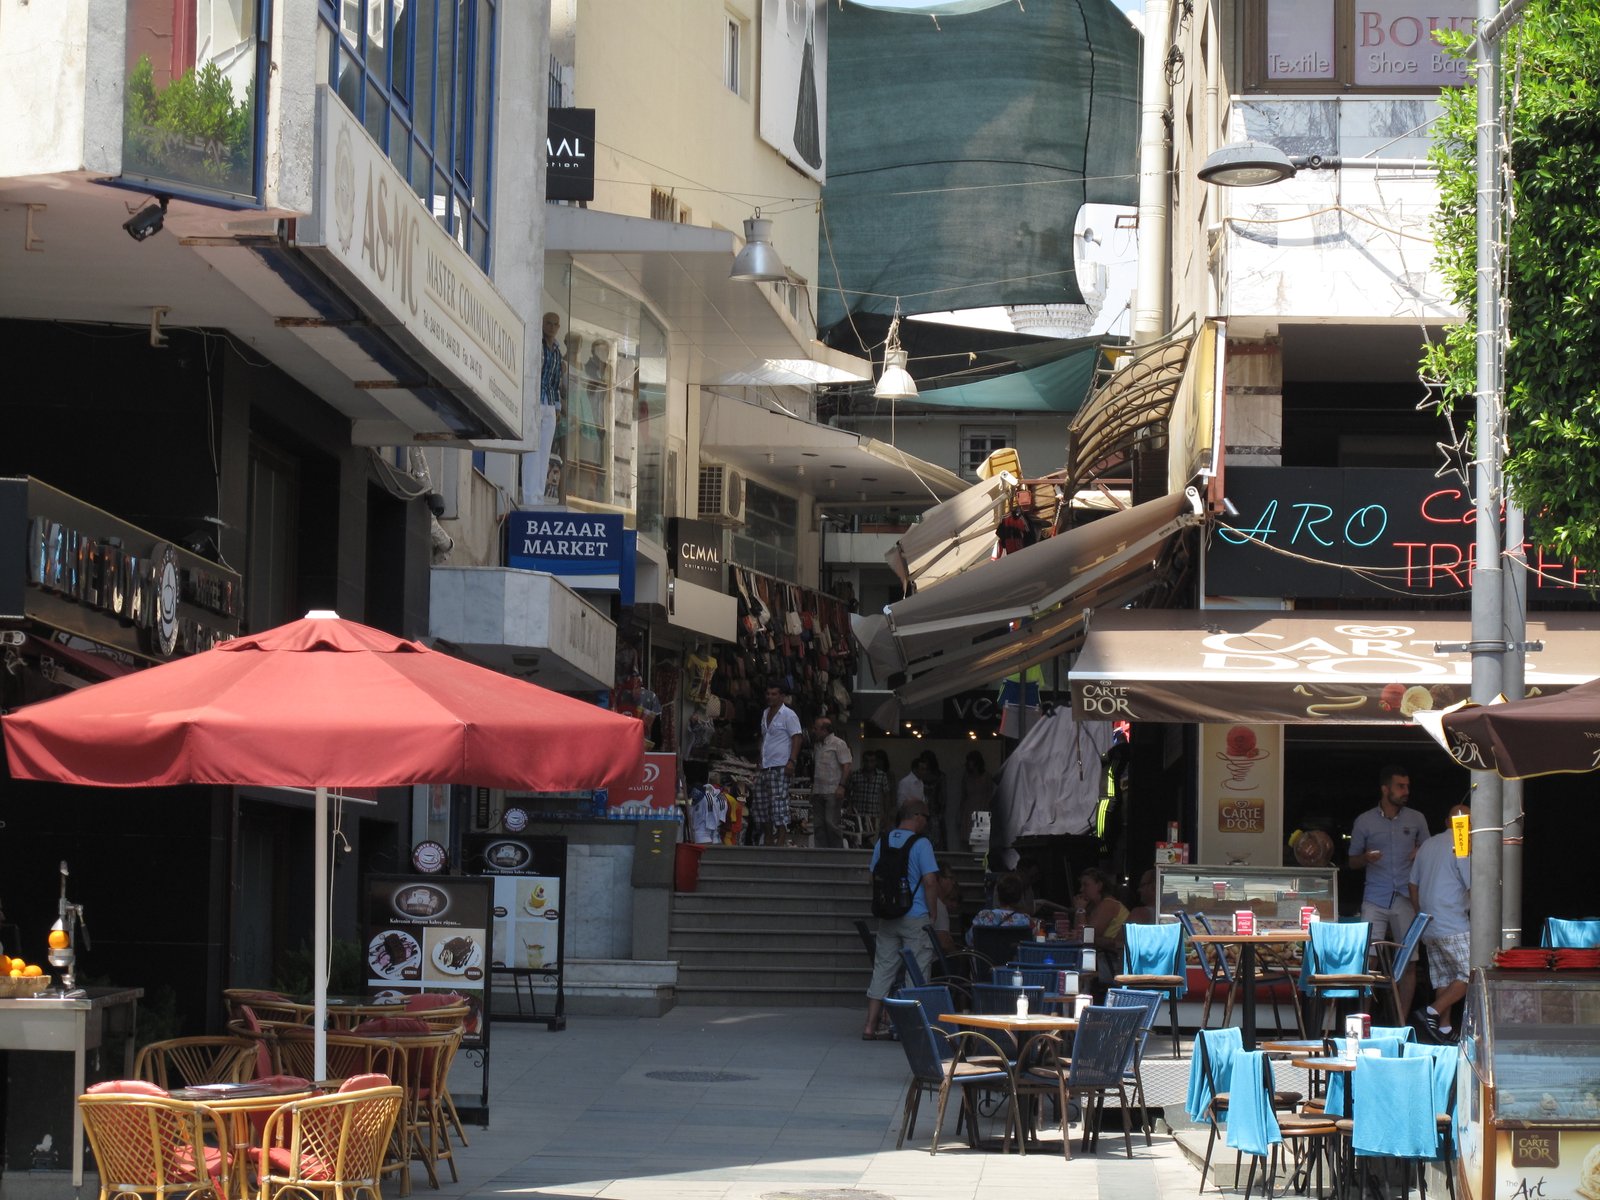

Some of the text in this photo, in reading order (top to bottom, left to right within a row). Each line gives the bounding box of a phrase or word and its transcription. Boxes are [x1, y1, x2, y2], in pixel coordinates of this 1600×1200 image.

[1269, 54, 1331, 73] Textile
[1369, 53, 1418, 74] Shoe
[426, 247, 456, 311] MASTER
[459, 282, 518, 376] COMMUNICATION
[526, 519, 607, 538] BAZAAR
[522, 539, 609, 557] MARKET
[681, 542, 720, 564] CEMAL
[1082, 684, 1130, 698] CARTE
[1083, 696, 1140, 719] D'OR
[1222, 806, 1262, 820] CARTE
[1226, 818, 1258, 831] D'OR
[1519, 1138, 1549, 1148] CARTE
[1520, 1147, 1556, 1162] D'OR
[1506, 1176, 1547, 1200] The Art
